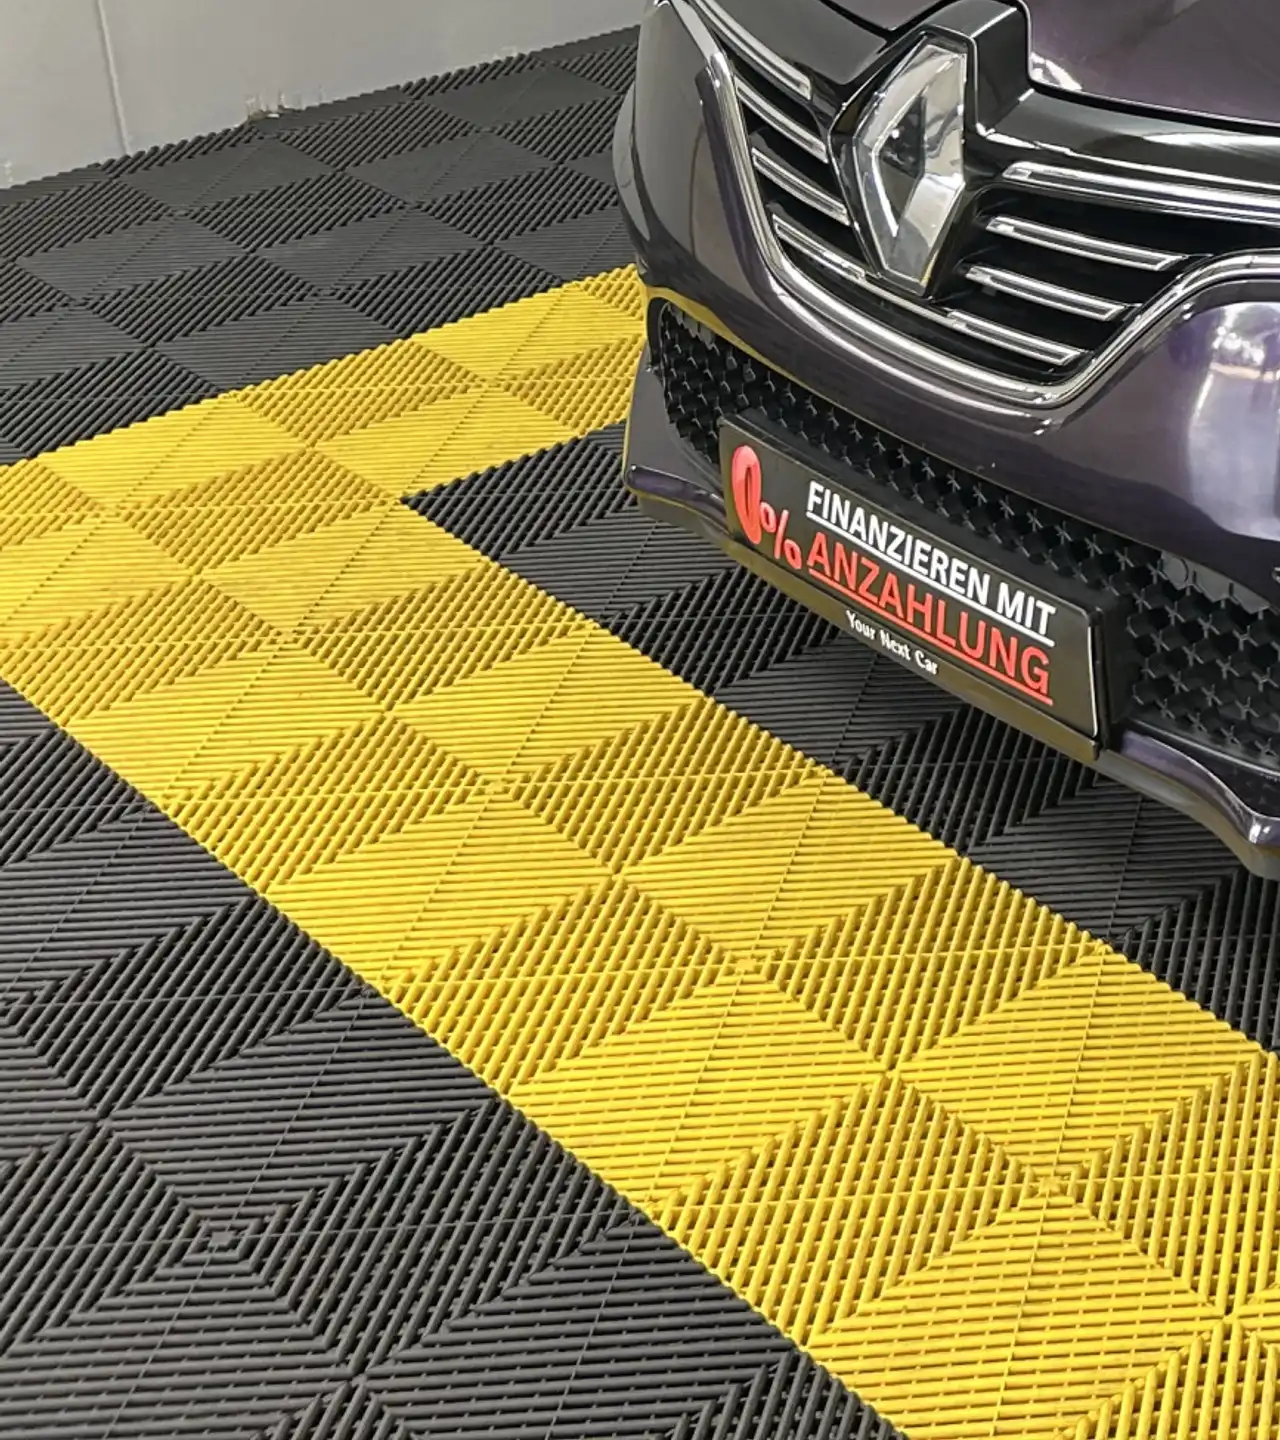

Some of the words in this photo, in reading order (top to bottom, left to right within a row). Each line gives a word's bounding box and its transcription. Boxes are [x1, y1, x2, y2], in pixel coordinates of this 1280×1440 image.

[731, 445, 802, 569] 0%
[806, 480, 990, 605] FINANZIEREN
[997, 582, 1056, 636] MIT
[806, 531, 1050, 695] ANZAHLUNG
[846, 610, 876, 640] Your
[880, 629, 911, 661] Next
[914, 650, 938, 675] Car
